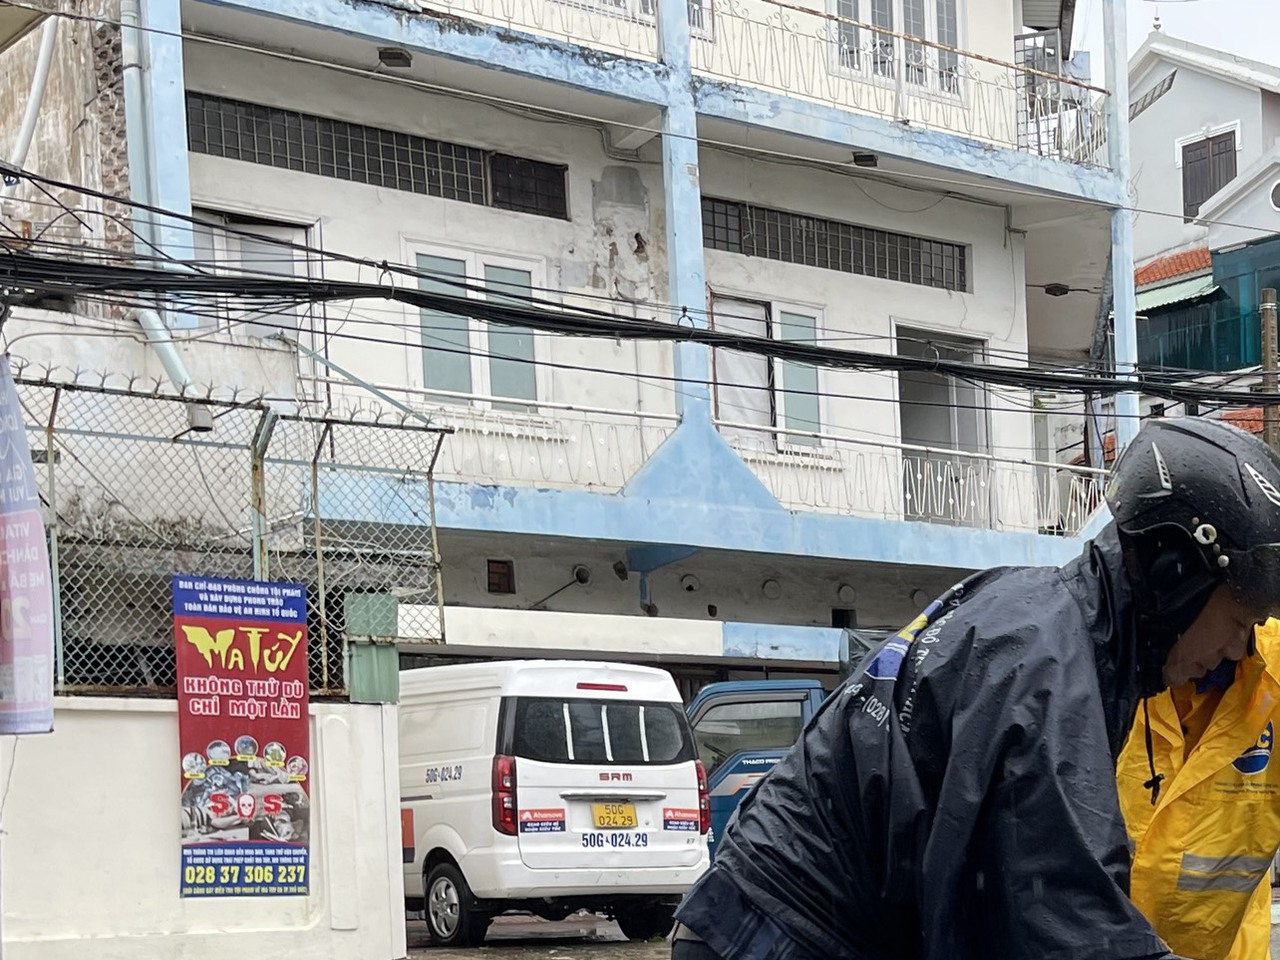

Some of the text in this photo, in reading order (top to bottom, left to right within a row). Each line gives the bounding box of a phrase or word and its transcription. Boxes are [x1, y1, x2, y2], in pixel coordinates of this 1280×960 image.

[181, 625, 303, 675] MA TÚY
[184, 675, 304, 699] KHÔNG THỬ DÙ
[189, 695, 301, 720] CHỈ MỘT LẦN
[604, 804, 624, 815] 50G
[185, 865, 305, 884] 028 37 306 237
